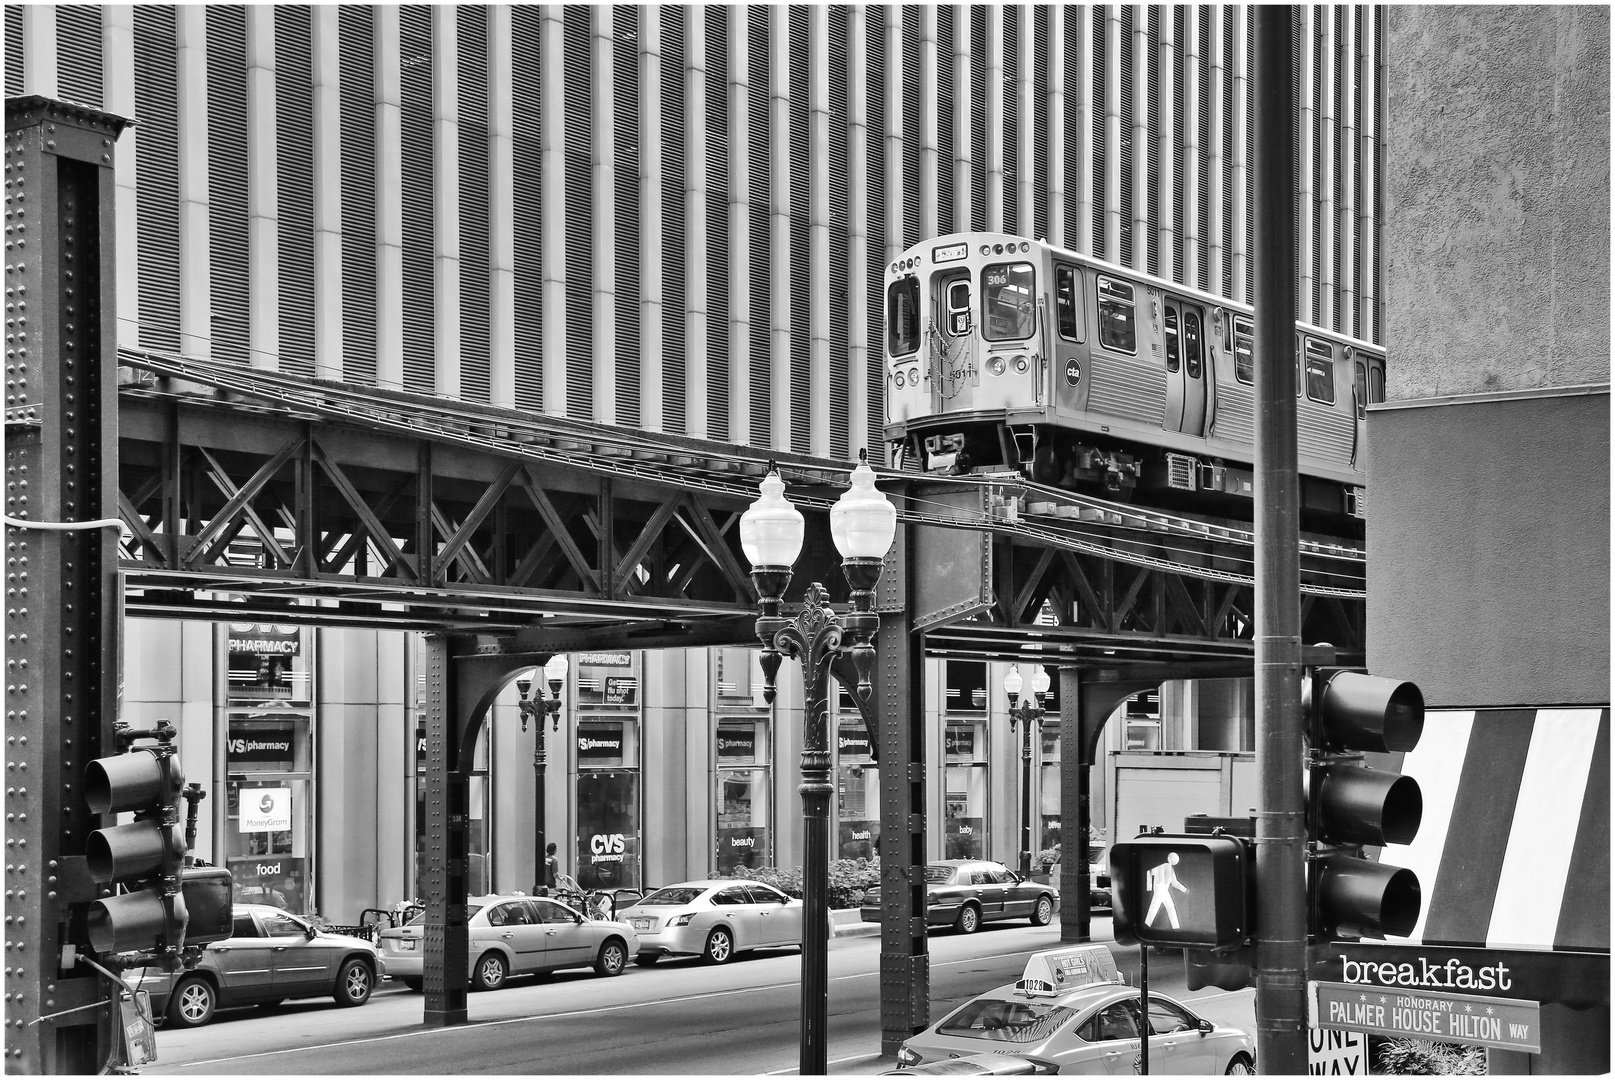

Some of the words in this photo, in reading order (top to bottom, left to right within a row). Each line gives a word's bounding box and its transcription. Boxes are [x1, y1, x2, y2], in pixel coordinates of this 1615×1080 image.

[987, 275, 1006, 285] 306
[1147, 286, 1160, 298] 5011
[1067, 367, 1080, 378] cta
[229, 639, 299, 653] PHARMACY
[579, 653, 631, 665] PHARMACY
[246, 818, 288, 828] MoneyGram
[852, 830, 871, 840] health
[959, 825, 973, 835] baby
[590, 833, 625, 854] CVS
[731, 837, 755, 848] beauty
[591, 853, 625, 864] pharmacy
[256, 862, 281, 876] food
[1340, 954, 1512, 990] breakfast
[1025, 979, 1043, 991] 1028
[1397, 996, 1454, 1013] HONORARY
[1330, 1001, 1385, 1028] PALMER
[1392, 1007, 1442, 1034] HOUSE
[1450, 1016, 1502, 1041] HILTON
[1509, 1023, 1529, 1040] WAY
